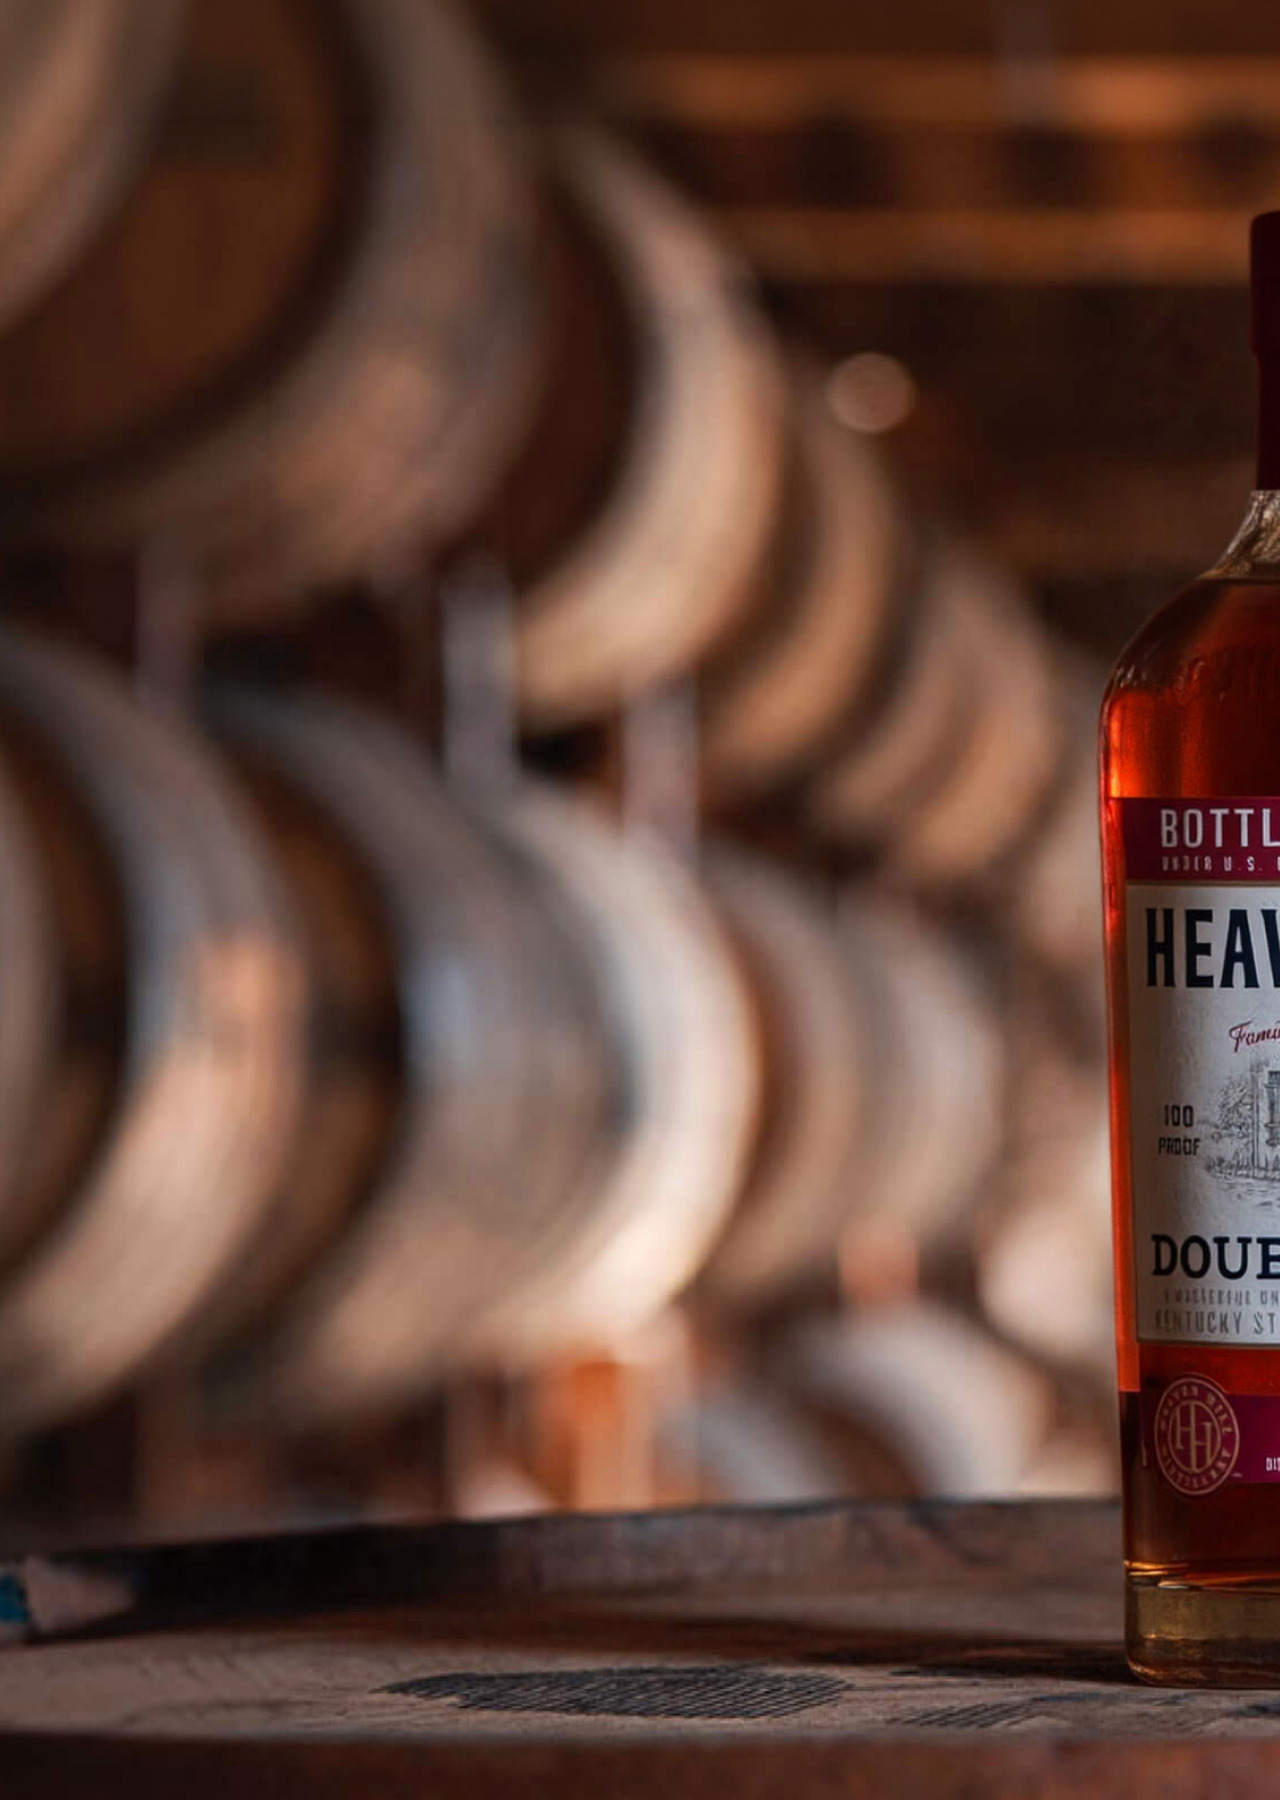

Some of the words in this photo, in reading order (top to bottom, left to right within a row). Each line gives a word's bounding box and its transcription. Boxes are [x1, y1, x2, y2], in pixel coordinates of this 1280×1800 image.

[1164, 1104, 1194, 1128] 100
[1157, 1136, 1201, 1156] PROOF
[1154, 1308, 1243, 1335] KENTUCKY
